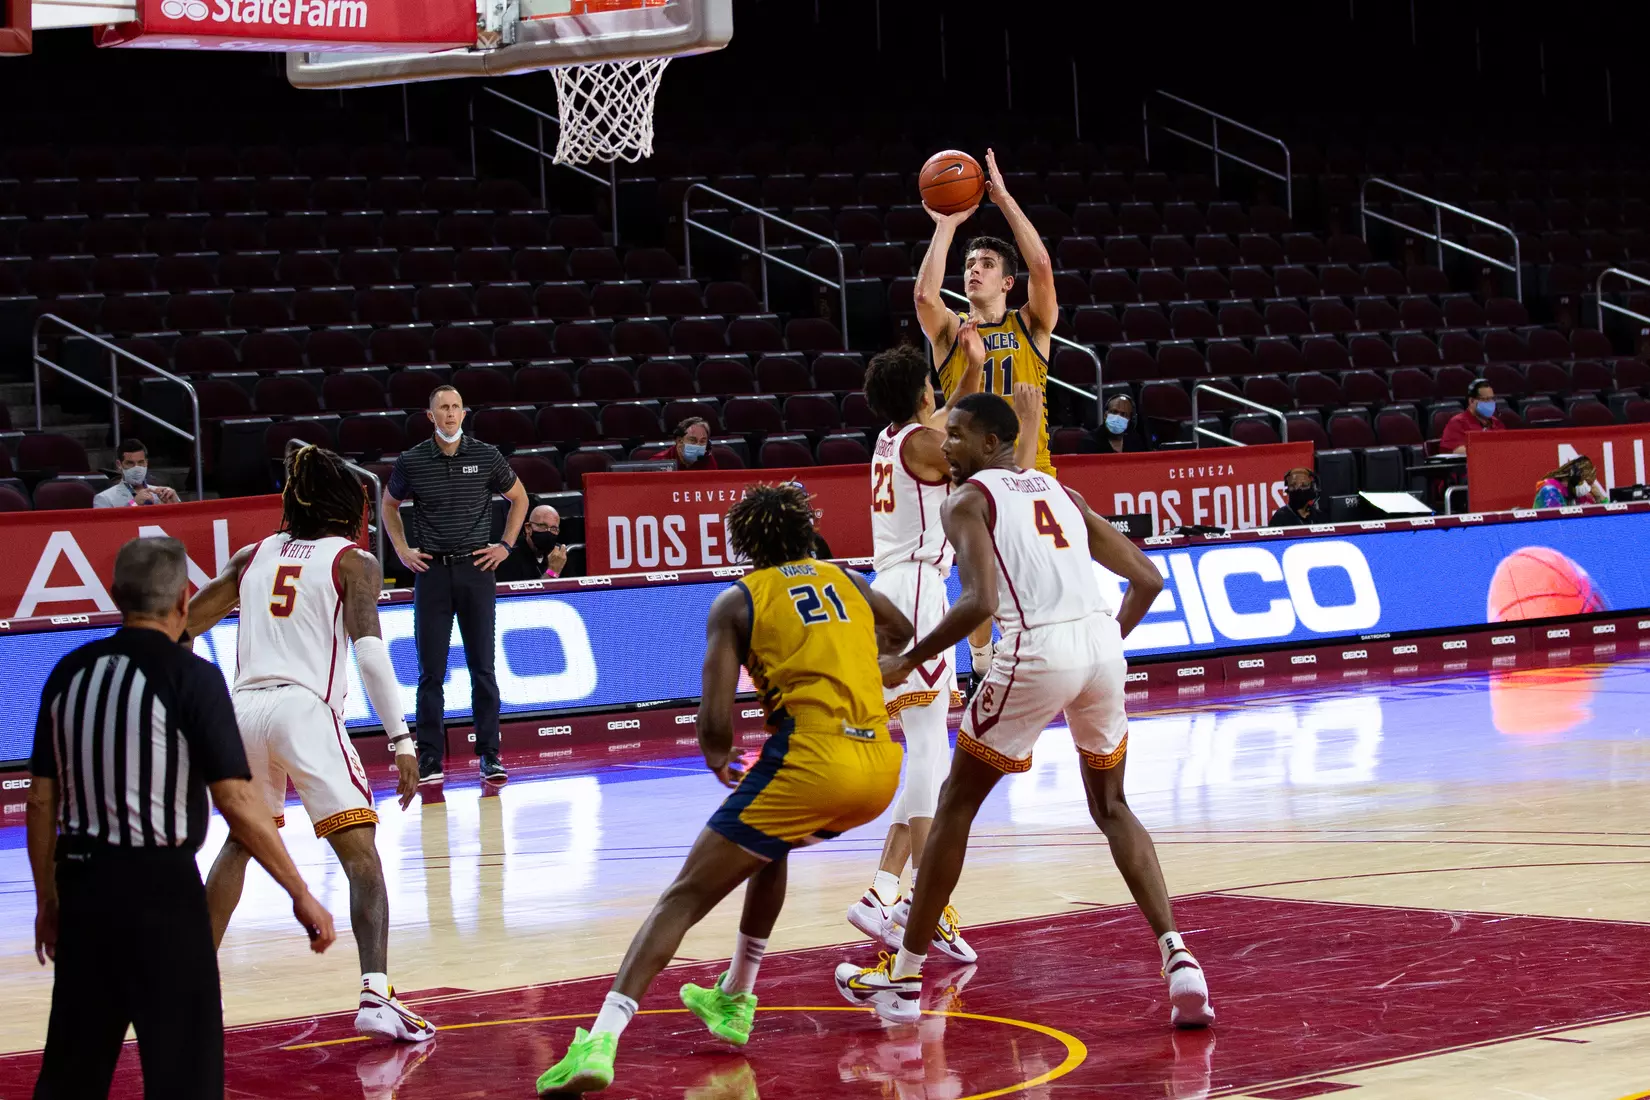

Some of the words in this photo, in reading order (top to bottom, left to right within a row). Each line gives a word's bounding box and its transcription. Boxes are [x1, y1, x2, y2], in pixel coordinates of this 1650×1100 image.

[982, 354, 1014, 396] 11
[462, 465, 479, 474] CBU
[1169, 465, 1235, 479] CERVEZA
[873, 462, 896, 513] 23
[672, 489, 748, 503] CERVEZA
[1033, 499, 1071, 549] 4
[607, 514, 688, 569] DOS
[279, 541, 316, 559] WHITE
[848, 558, 874, 567] GEIC
[712, 567, 745, 577] GEICO
[777, 564, 818, 578] WADE
[579, 577, 612, 586] GEICO
[646, 572, 679, 582] GEICO
[269, 564, 302, 618] 5
[509, 581, 544, 590] GEICO
[788, 583, 850, 626] 21
[51, 614, 89, 625] GEICO
[1238, 659, 1265, 669] GEICO
[1291, 655, 1317, 665] GEICO
[1177, 667, 1205, 677] GEICO
[741, 708, 765, 718] GEIC
[607, 719, 641, 730] GEICO
[675, 714, 699, 725] GEIC
[538, 725, 572, 737] GEICO
[2, 778, 33, 790] GEIC
